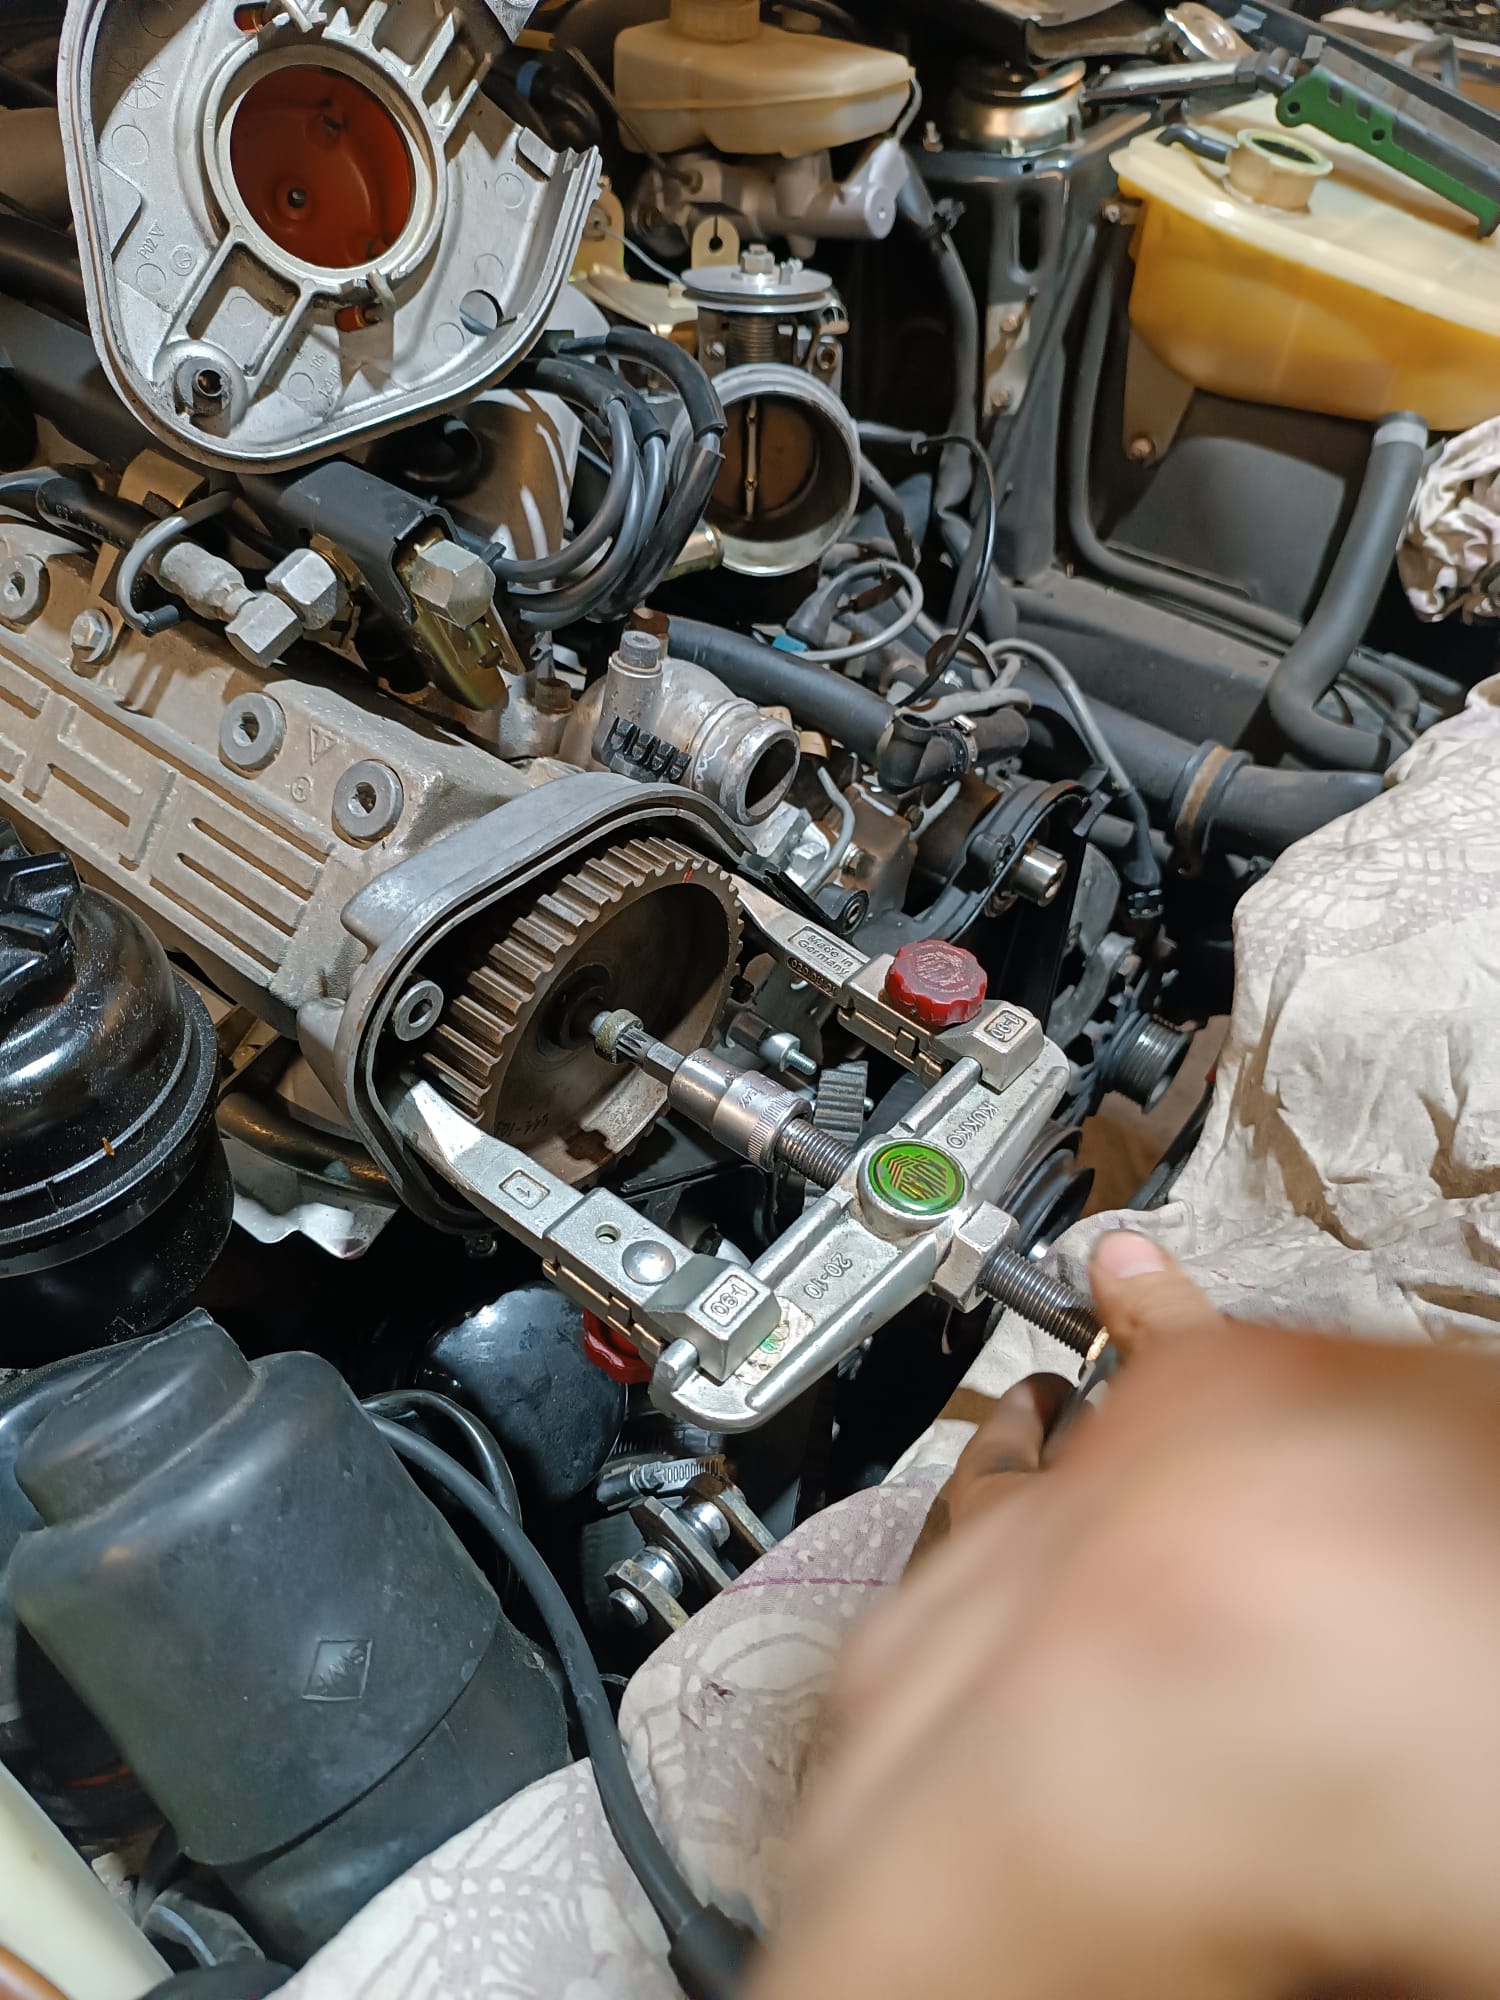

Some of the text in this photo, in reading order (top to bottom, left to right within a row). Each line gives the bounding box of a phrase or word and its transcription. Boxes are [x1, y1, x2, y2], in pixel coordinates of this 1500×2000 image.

[797, 939, 852, 977] Germany
[806, 933, 840, 959] Made
[946, 1101, 998, 1149] KUKKO
[803, 1252, 852, 1301] 20-10
